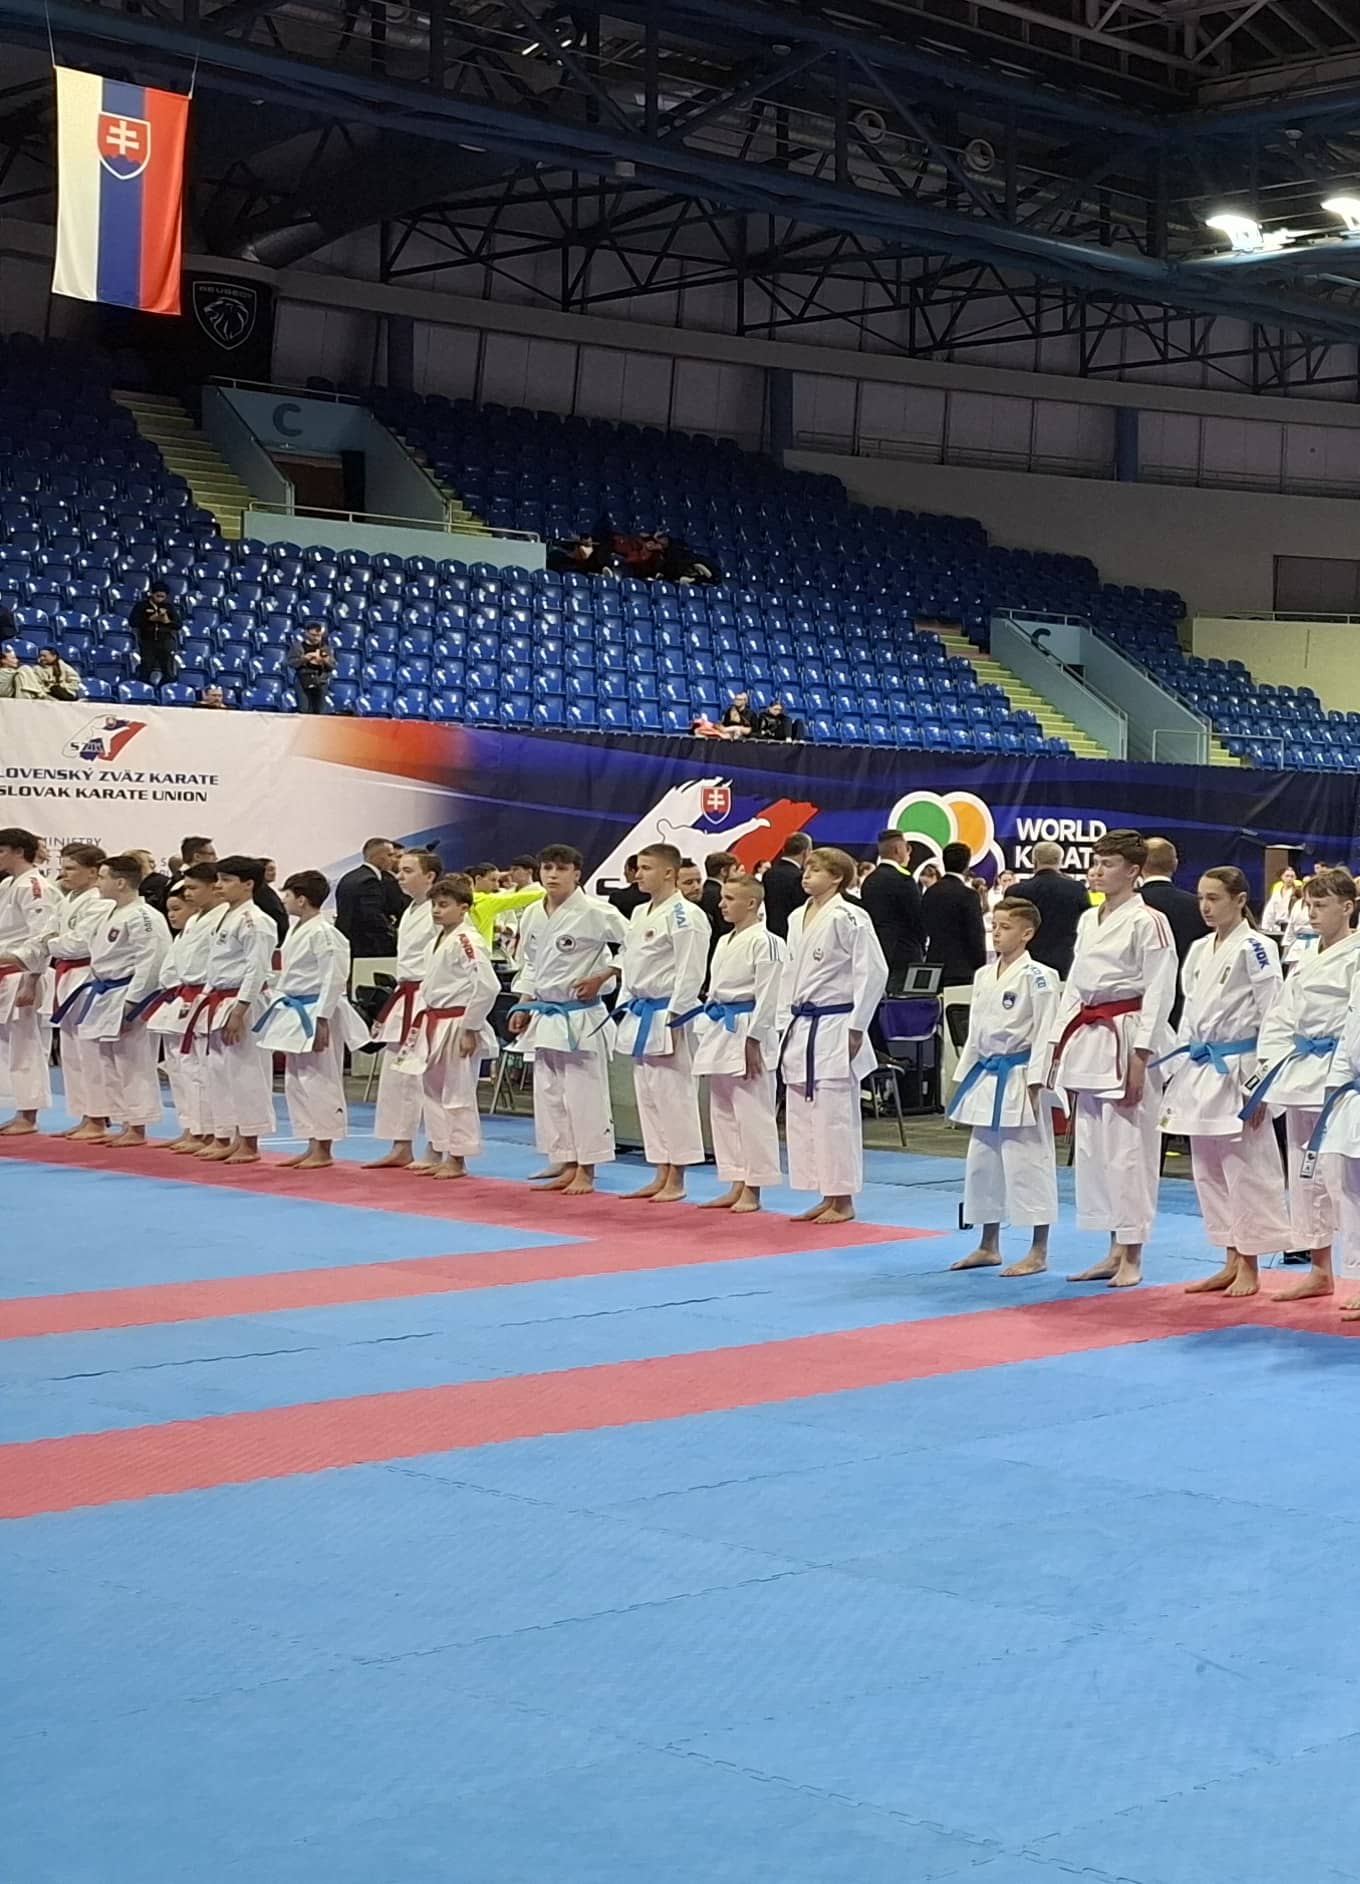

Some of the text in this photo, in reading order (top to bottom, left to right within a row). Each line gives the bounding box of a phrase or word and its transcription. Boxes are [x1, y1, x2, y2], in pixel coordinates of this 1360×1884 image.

[273, 403, 303, 437] C
[100, 769, 145, 783] ZVÄZ
[150, 773, 219, 786] KARATE
[0, 785, 208, 802] SLOVAK KARATE UNION
[1016, 818, 1107, 842] WORLD
